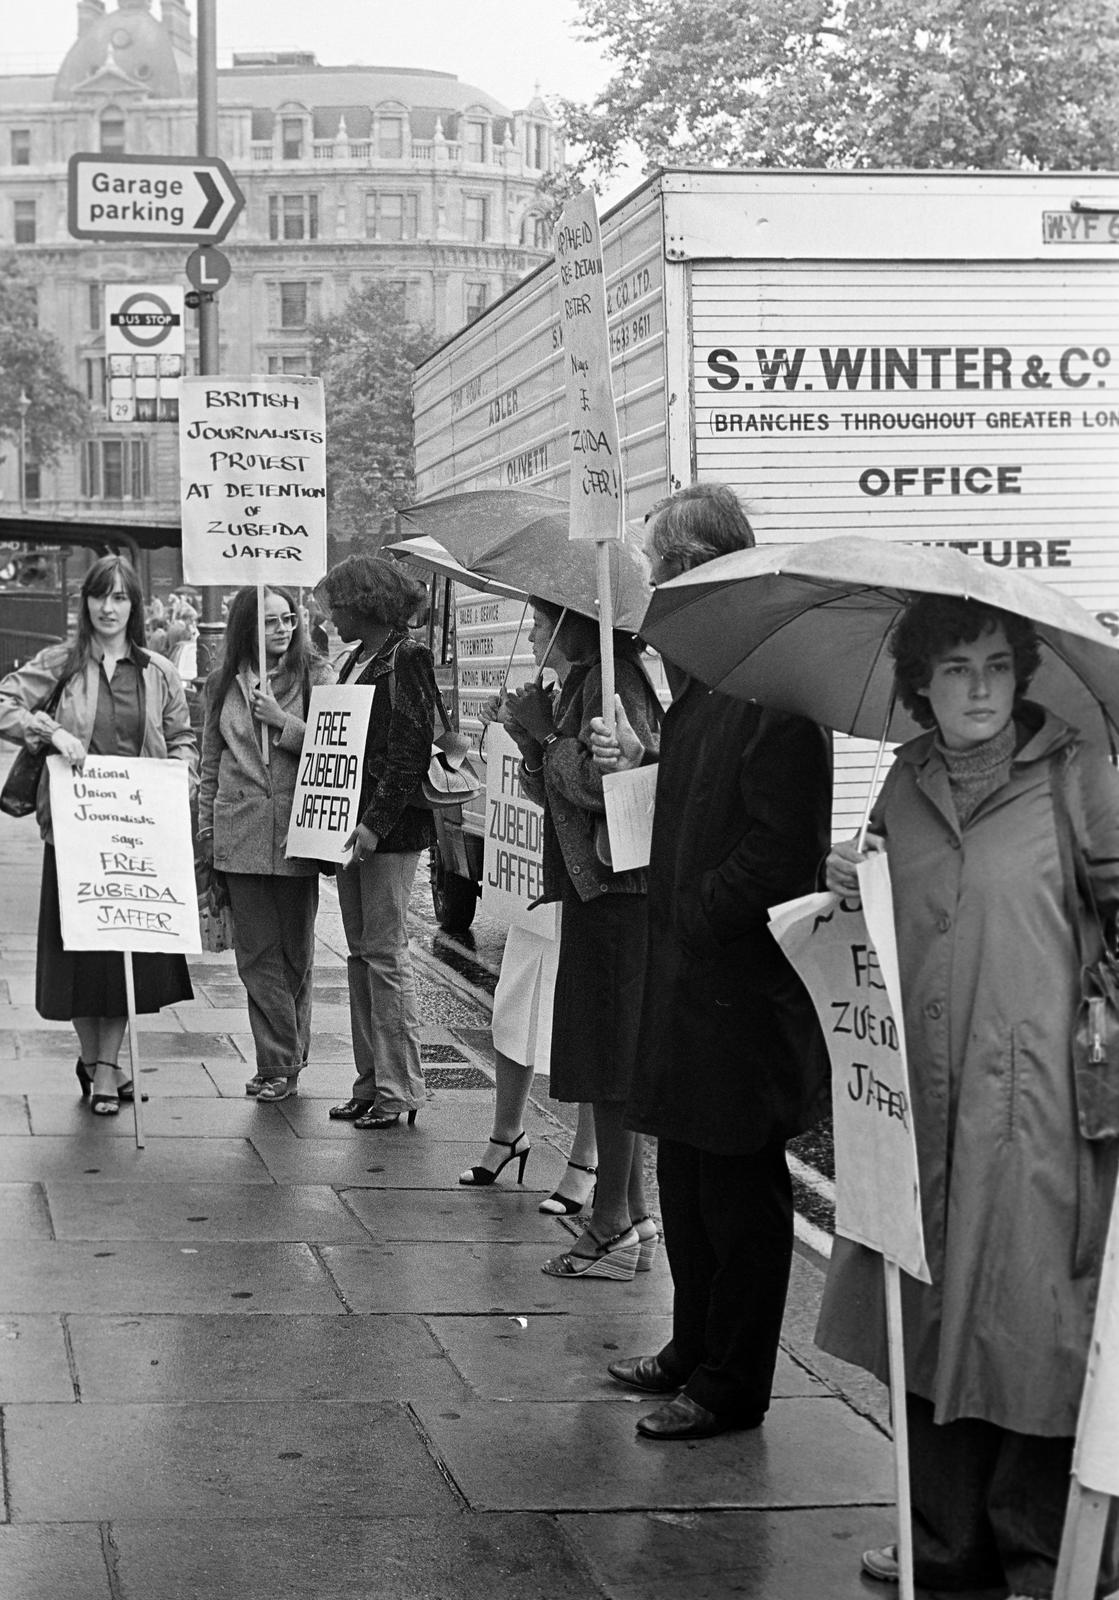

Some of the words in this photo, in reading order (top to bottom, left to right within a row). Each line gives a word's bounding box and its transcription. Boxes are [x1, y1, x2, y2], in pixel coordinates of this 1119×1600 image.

[92, 172, 183, 198] Garage
[90, 201, 184, 226] parking
[1047, 213, 1100, 239] WYF
[119, 315, 140, 325] BUS
[146, 315, 172, 325] STOP
[115, 404, 129, 417] 29
[205, 390, 299, 410] BRITISH
[488, 387, 519, 428] ADLER
[187, 420, 324, 444] JOURNALISTS
[841, 412, 976, 431] THROUGHOUT
[986, 411, 1072, 429] GREATER
[210, 451, 311, 472] PROTEST
[507, 443, 548, 485] OLIVETTI
[186, 483, 213, 500] AT
[224, 483, 326, 499] DETENTION
[858, 466, 1022, 497] OFFICE
[244, 506, 262, 517] OF
[206, 521, 309, 538] ZUBEIDA
[222, 543, 304, 562] JAFFER
[460, 638, 494, 656] TYPEWRITERS
[462, 670, 479, 687] ADDING
[314, 711, 352, 747] FREE
[300, 752, 358, 790] ZUBEIDA
[74, 783, 117, 799] Union
[130, 789, 143, 805] of
[74, 803, 156, 825] Journalists
[296, 793, 351, 832] JAFFER
[111, 834, 144, 849] says
[100, 852, 156, 873] FREE
[77, 882, 179, 904] ZUBEIDA
[97, 905, 173, 931] JAFFER
